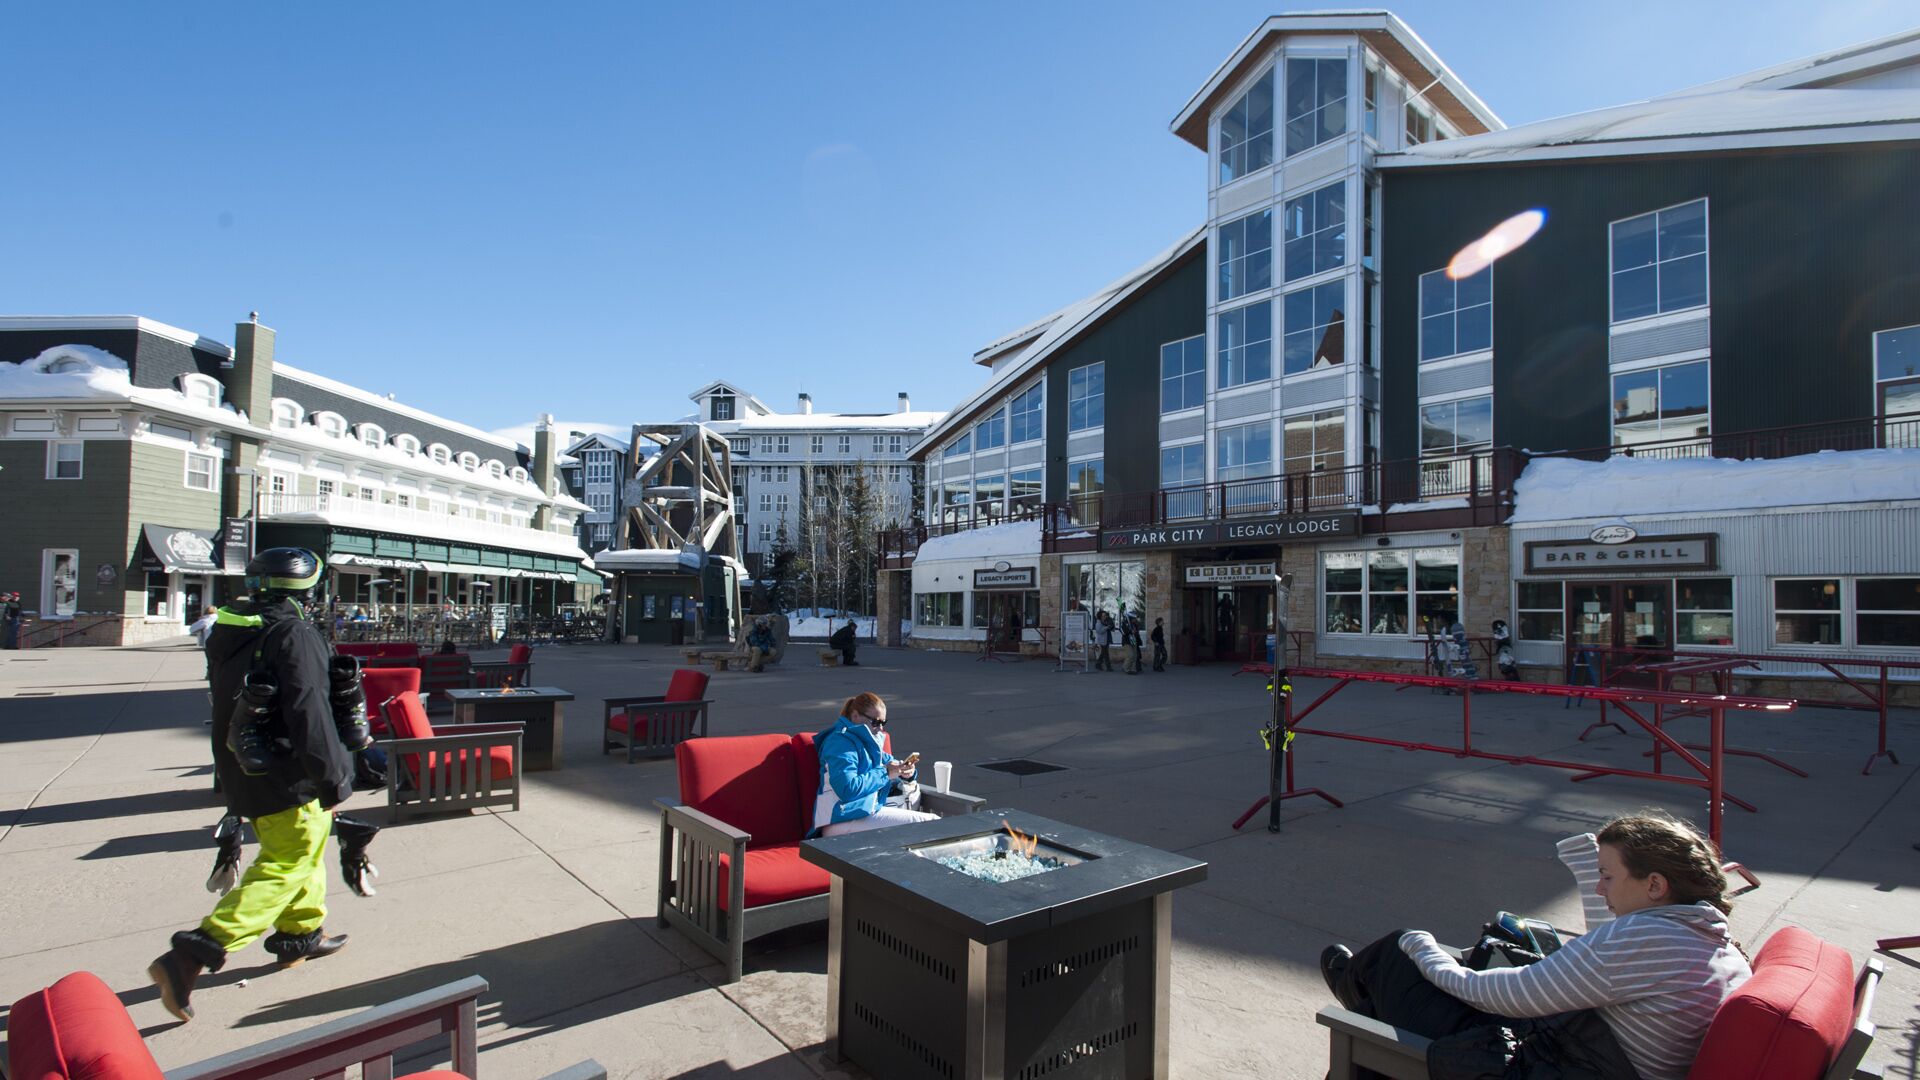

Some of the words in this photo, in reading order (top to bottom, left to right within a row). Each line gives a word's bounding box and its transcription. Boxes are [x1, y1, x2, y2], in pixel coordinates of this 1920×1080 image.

[1229, 523, 1283, 537] LEGACY
[1289, 519, 1340, 534] LODGE
[1133, 531, 1166, 544] PARK
[1172, 529, 1204, 542] CITY
[1546, 552, 1586, 562] BAR
[1596, 551, 1608, 560] &
[1617, 548, 1688, 559] GRILL
